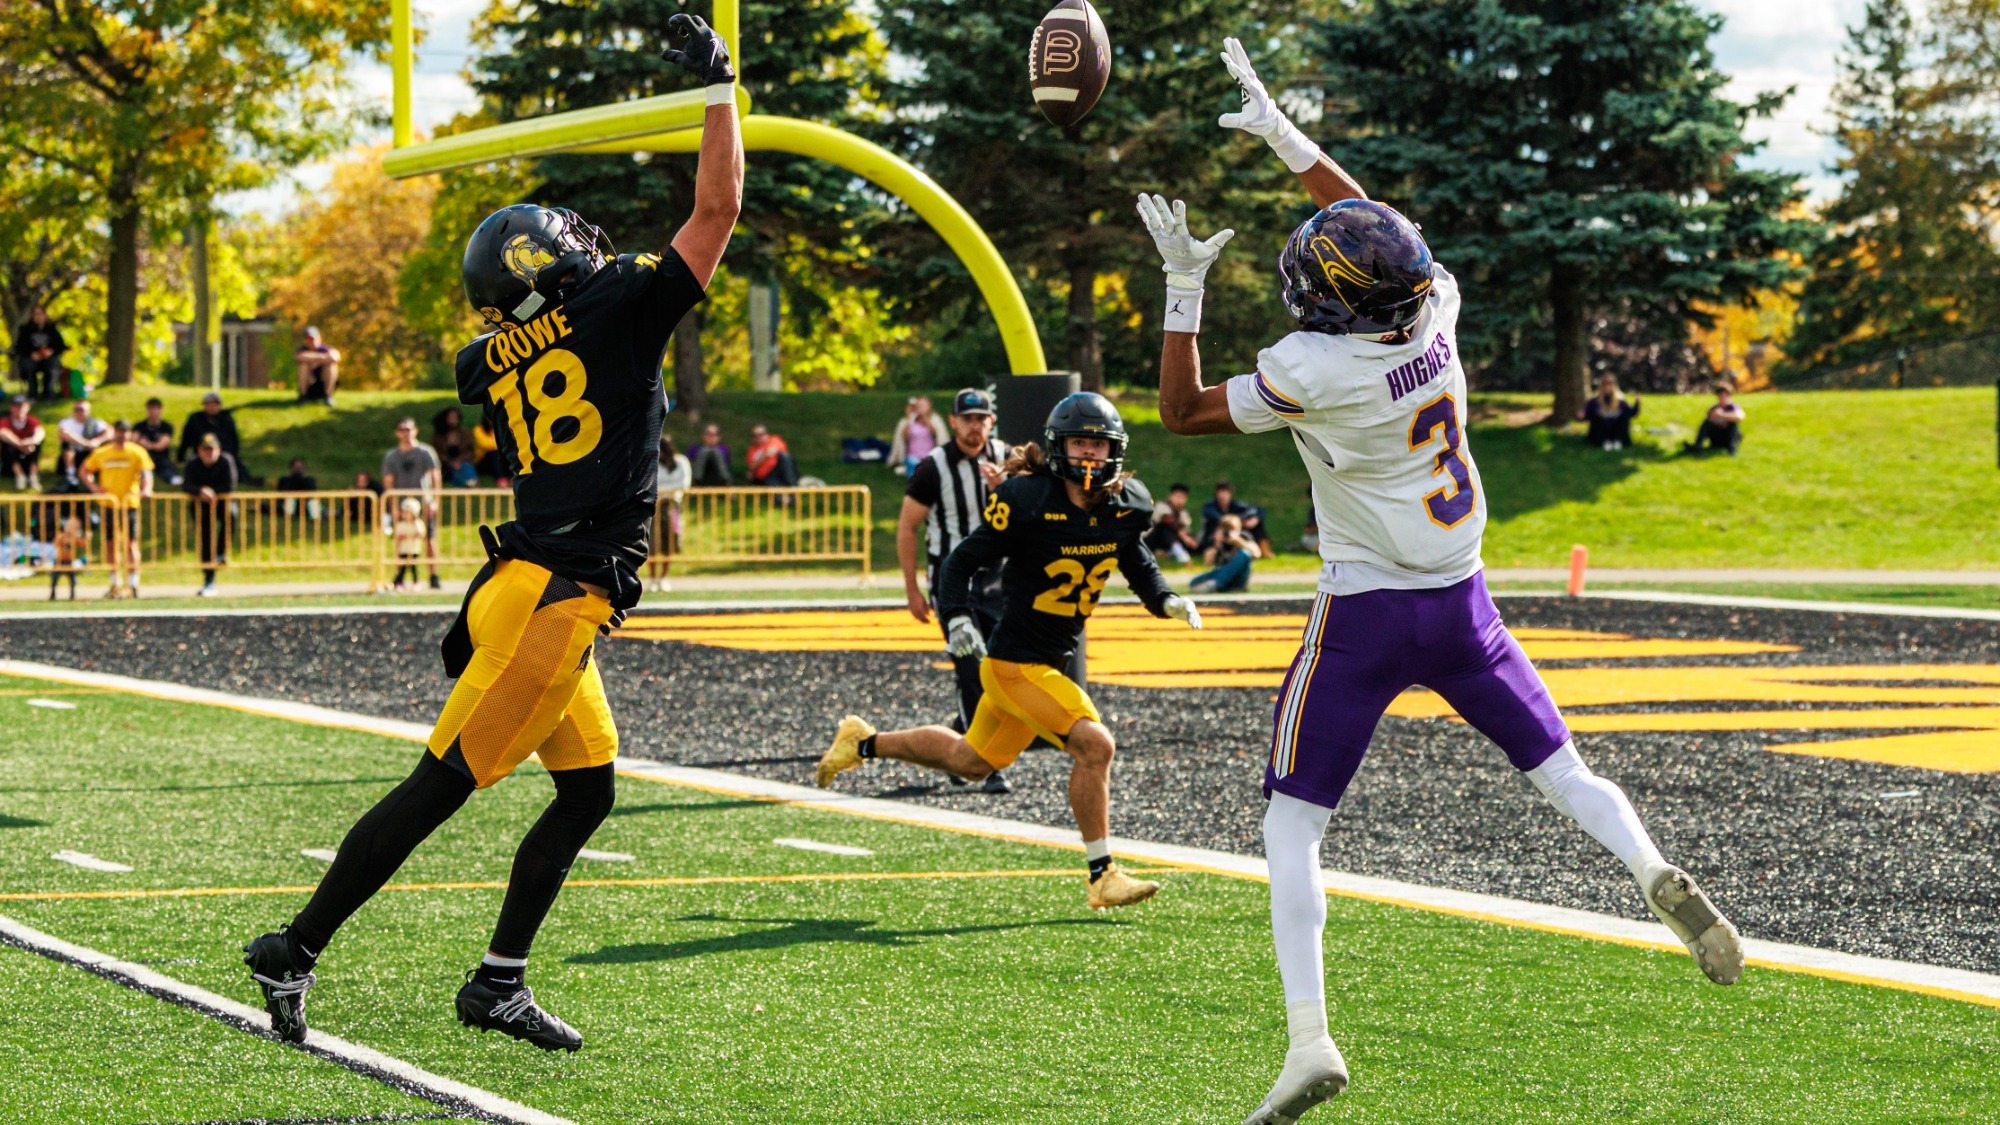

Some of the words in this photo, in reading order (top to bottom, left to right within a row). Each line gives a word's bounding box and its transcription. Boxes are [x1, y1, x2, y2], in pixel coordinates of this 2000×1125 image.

[486, 305, 573, 373] CROWE
[1385, 332, 1451, 402] HUGHES
[488, 348, 603, 475] 18
[1408, 392, 1477, 531] 3
[984, 493, 1010, 531] 28
[1044, 513, 1068, 521] OUA
[1061, 543, 1117, 555] WARRIORS
[1032, 557, 1119, 617] 28
